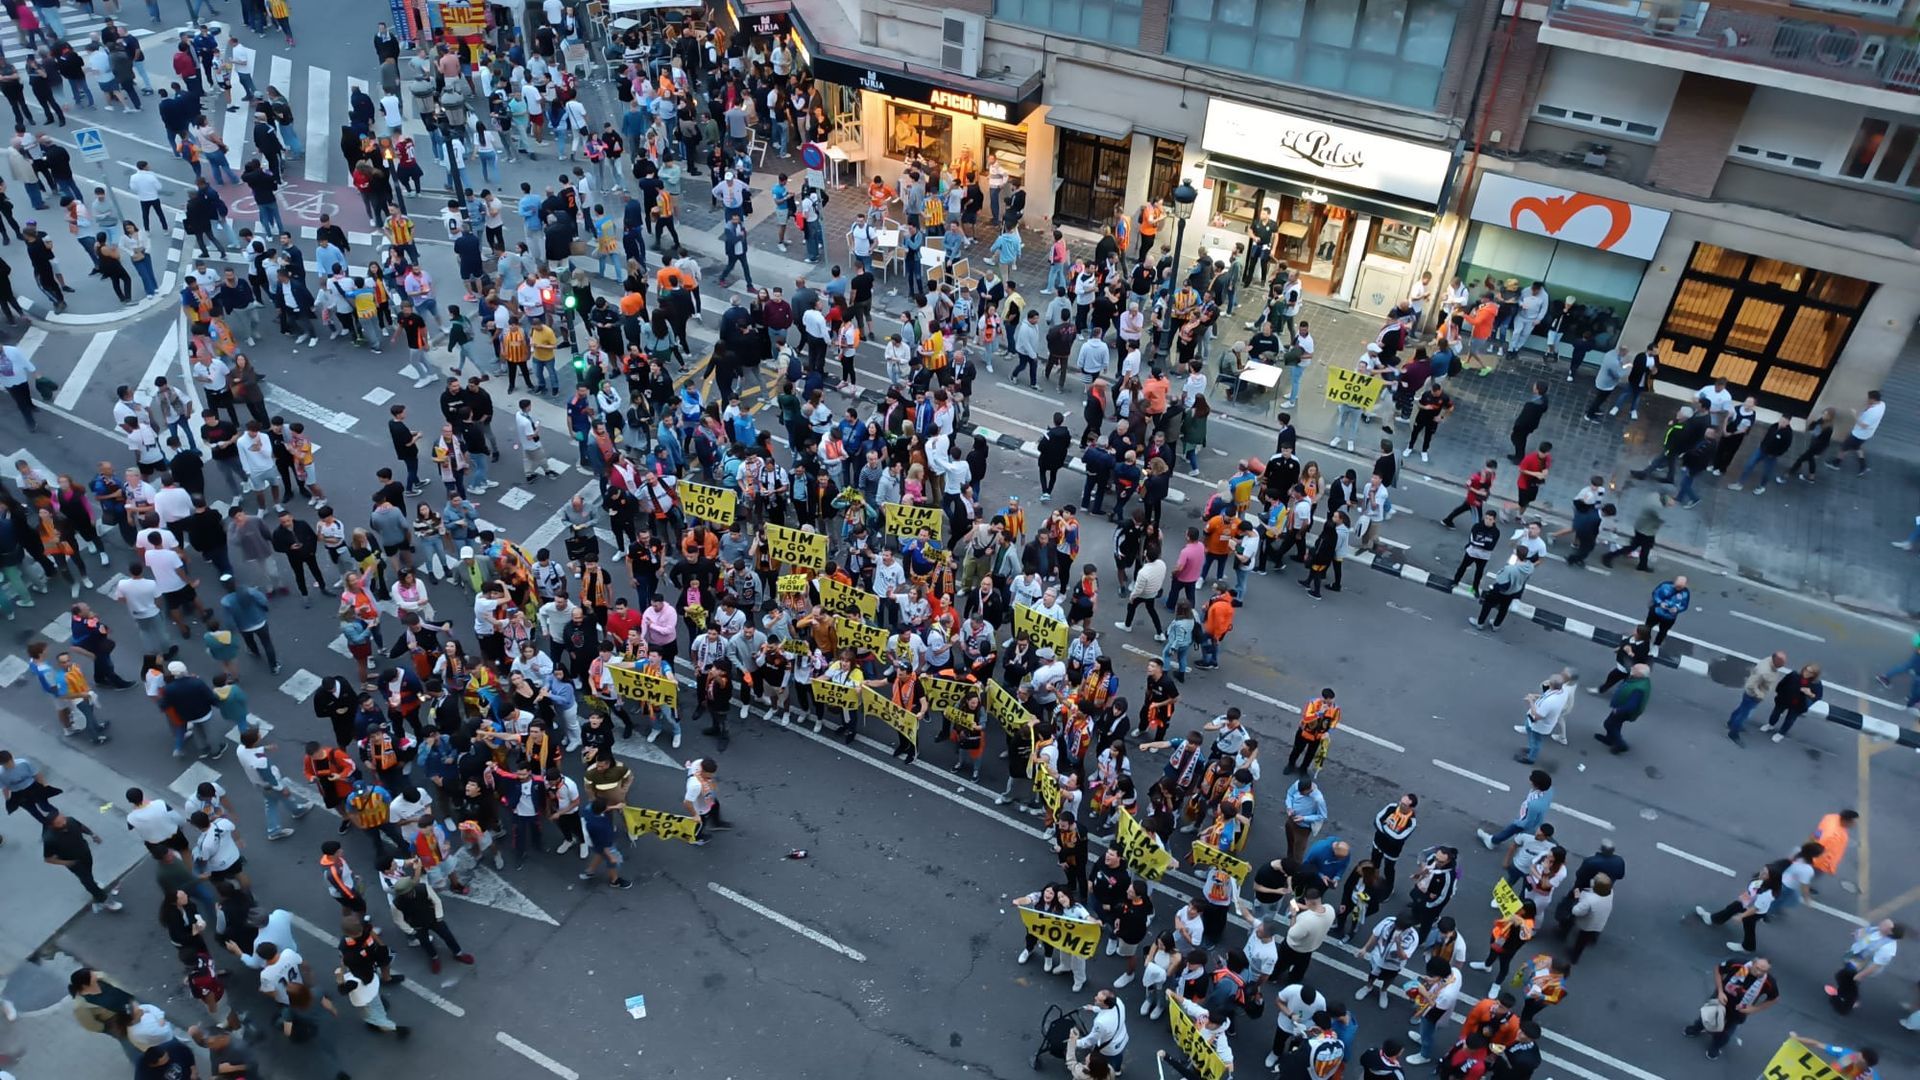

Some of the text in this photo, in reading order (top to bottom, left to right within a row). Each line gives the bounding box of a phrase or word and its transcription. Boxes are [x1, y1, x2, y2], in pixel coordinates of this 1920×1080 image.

[752, 23, 779, 33] TURIA
[859, 78, 885, 91] TURIA
[1339, 370, 1373, 387] LIM
[1344, 383, 1361, 393] GO
[1328, 388, 1373, 407] HOME
[689, 483, 724, 498] LIM
[697, 495, 715, 505] GO
[685, 501, 731, 522] HOME
[897, 507, 933, 519] LIM
[779, 528, 814, 545] LIM
[888, 524, 939, 539] HOE
[787, 542, 806, 553] GO
[772, 547, 823, 568] HOME
[831, 580, 865, 600] LIM
[839, 594, 856, 605] GO
[845, 619, 881, 637] LIM
[1025, 609, 1059, 632] LIM
[853, 632, 872, 642] GO
[1033, 624, 1049, 637] GO
[838, 637, 888, 662] HOME
[633, 679, 654, 689] GO
[821, 682, 849, 694] LIM
[932, 679, 972, 695] LIM
[618, 682, 675, 706] HOME
[816, 694, 857, 709] HOME
[828, 690, 843, 698] GO
[940, 691, 961, 702] GO
[874, 694, 906, 719] LIM
[996, 688, 1025, 720] LIM
[867, 704, 916, 740] HOME
[1000, 707, 1014, 723] GO
[641, 809, 684, 823] LIM
[651, 820, 673, 829] GO
[1128, 819, 1161, 854] LIM
[1502, 885, 1519, 903] LIM
[1494, 890, 1512, 917] HOME
[1031, 924, 1096, 957] HOME
